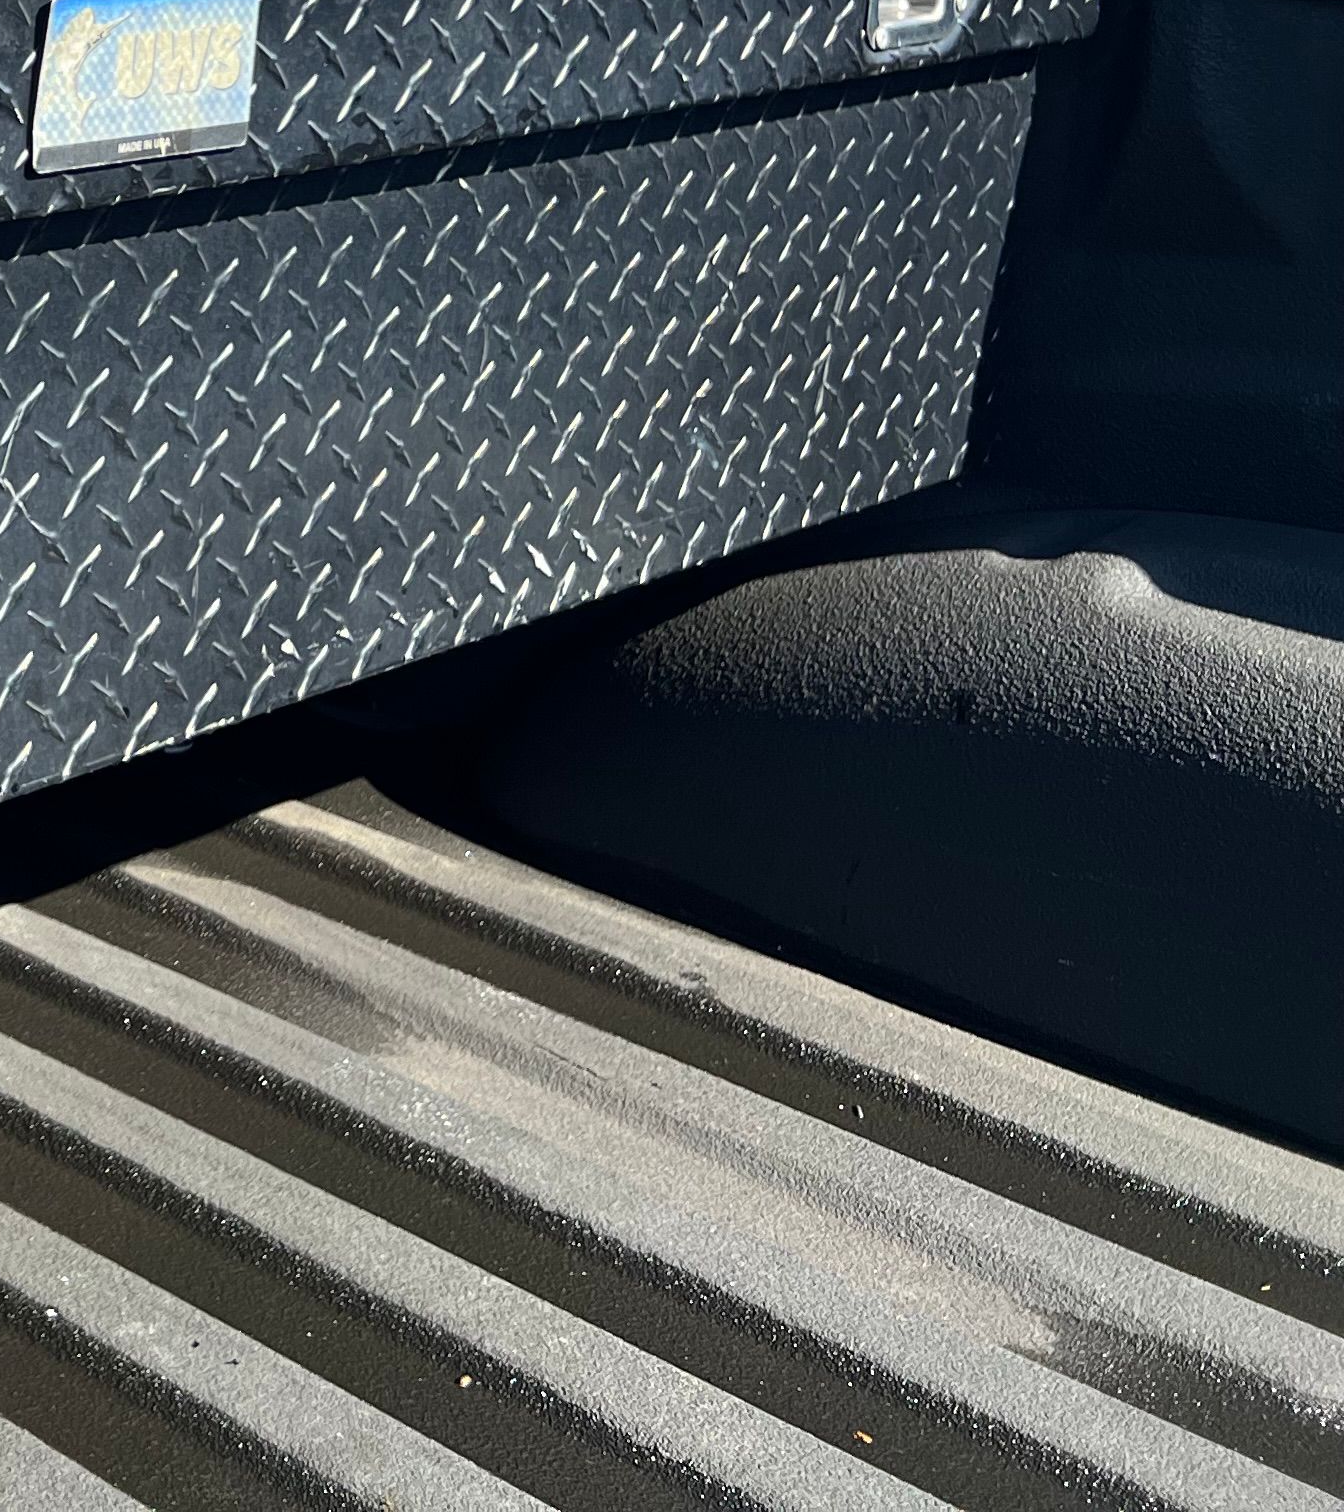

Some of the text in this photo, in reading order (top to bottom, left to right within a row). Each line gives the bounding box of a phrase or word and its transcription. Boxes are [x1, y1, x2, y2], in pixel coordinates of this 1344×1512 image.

[116, 23, 241, 100] UWS
[117, 140, 143, 154] MADE
[143, 138, 153, 150] IN
